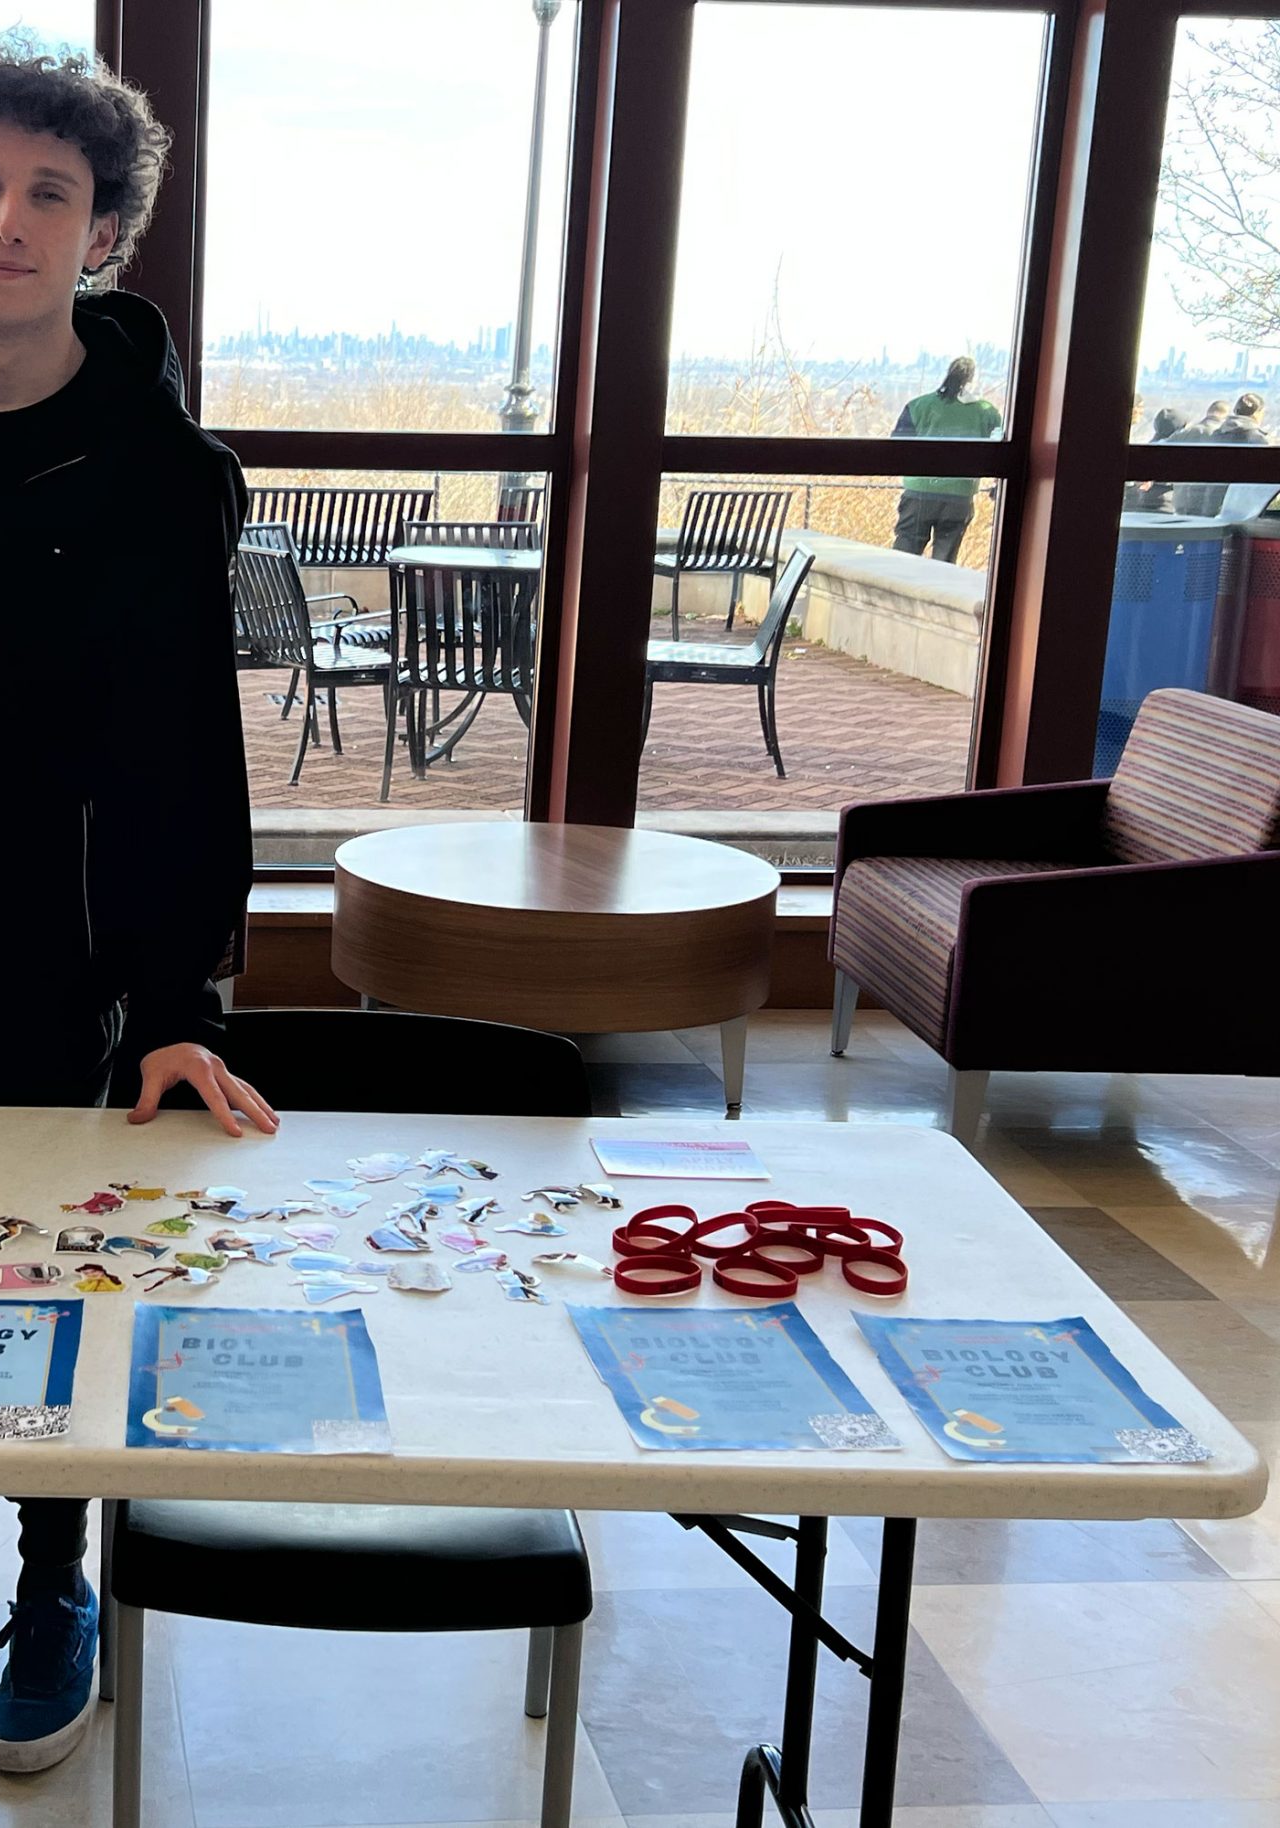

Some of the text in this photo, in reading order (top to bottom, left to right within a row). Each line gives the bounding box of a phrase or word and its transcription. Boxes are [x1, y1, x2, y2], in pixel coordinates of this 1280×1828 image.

[630, 1336, 776, 1350] BIOLOGY
[212, 1353, 304, 1367] CLUB
[670, 1351, 761, 1364] CLUB
[921, 1349, 1070, 1363] BIOLOGY
[965, 1365, 1058, 1379] CLUB
